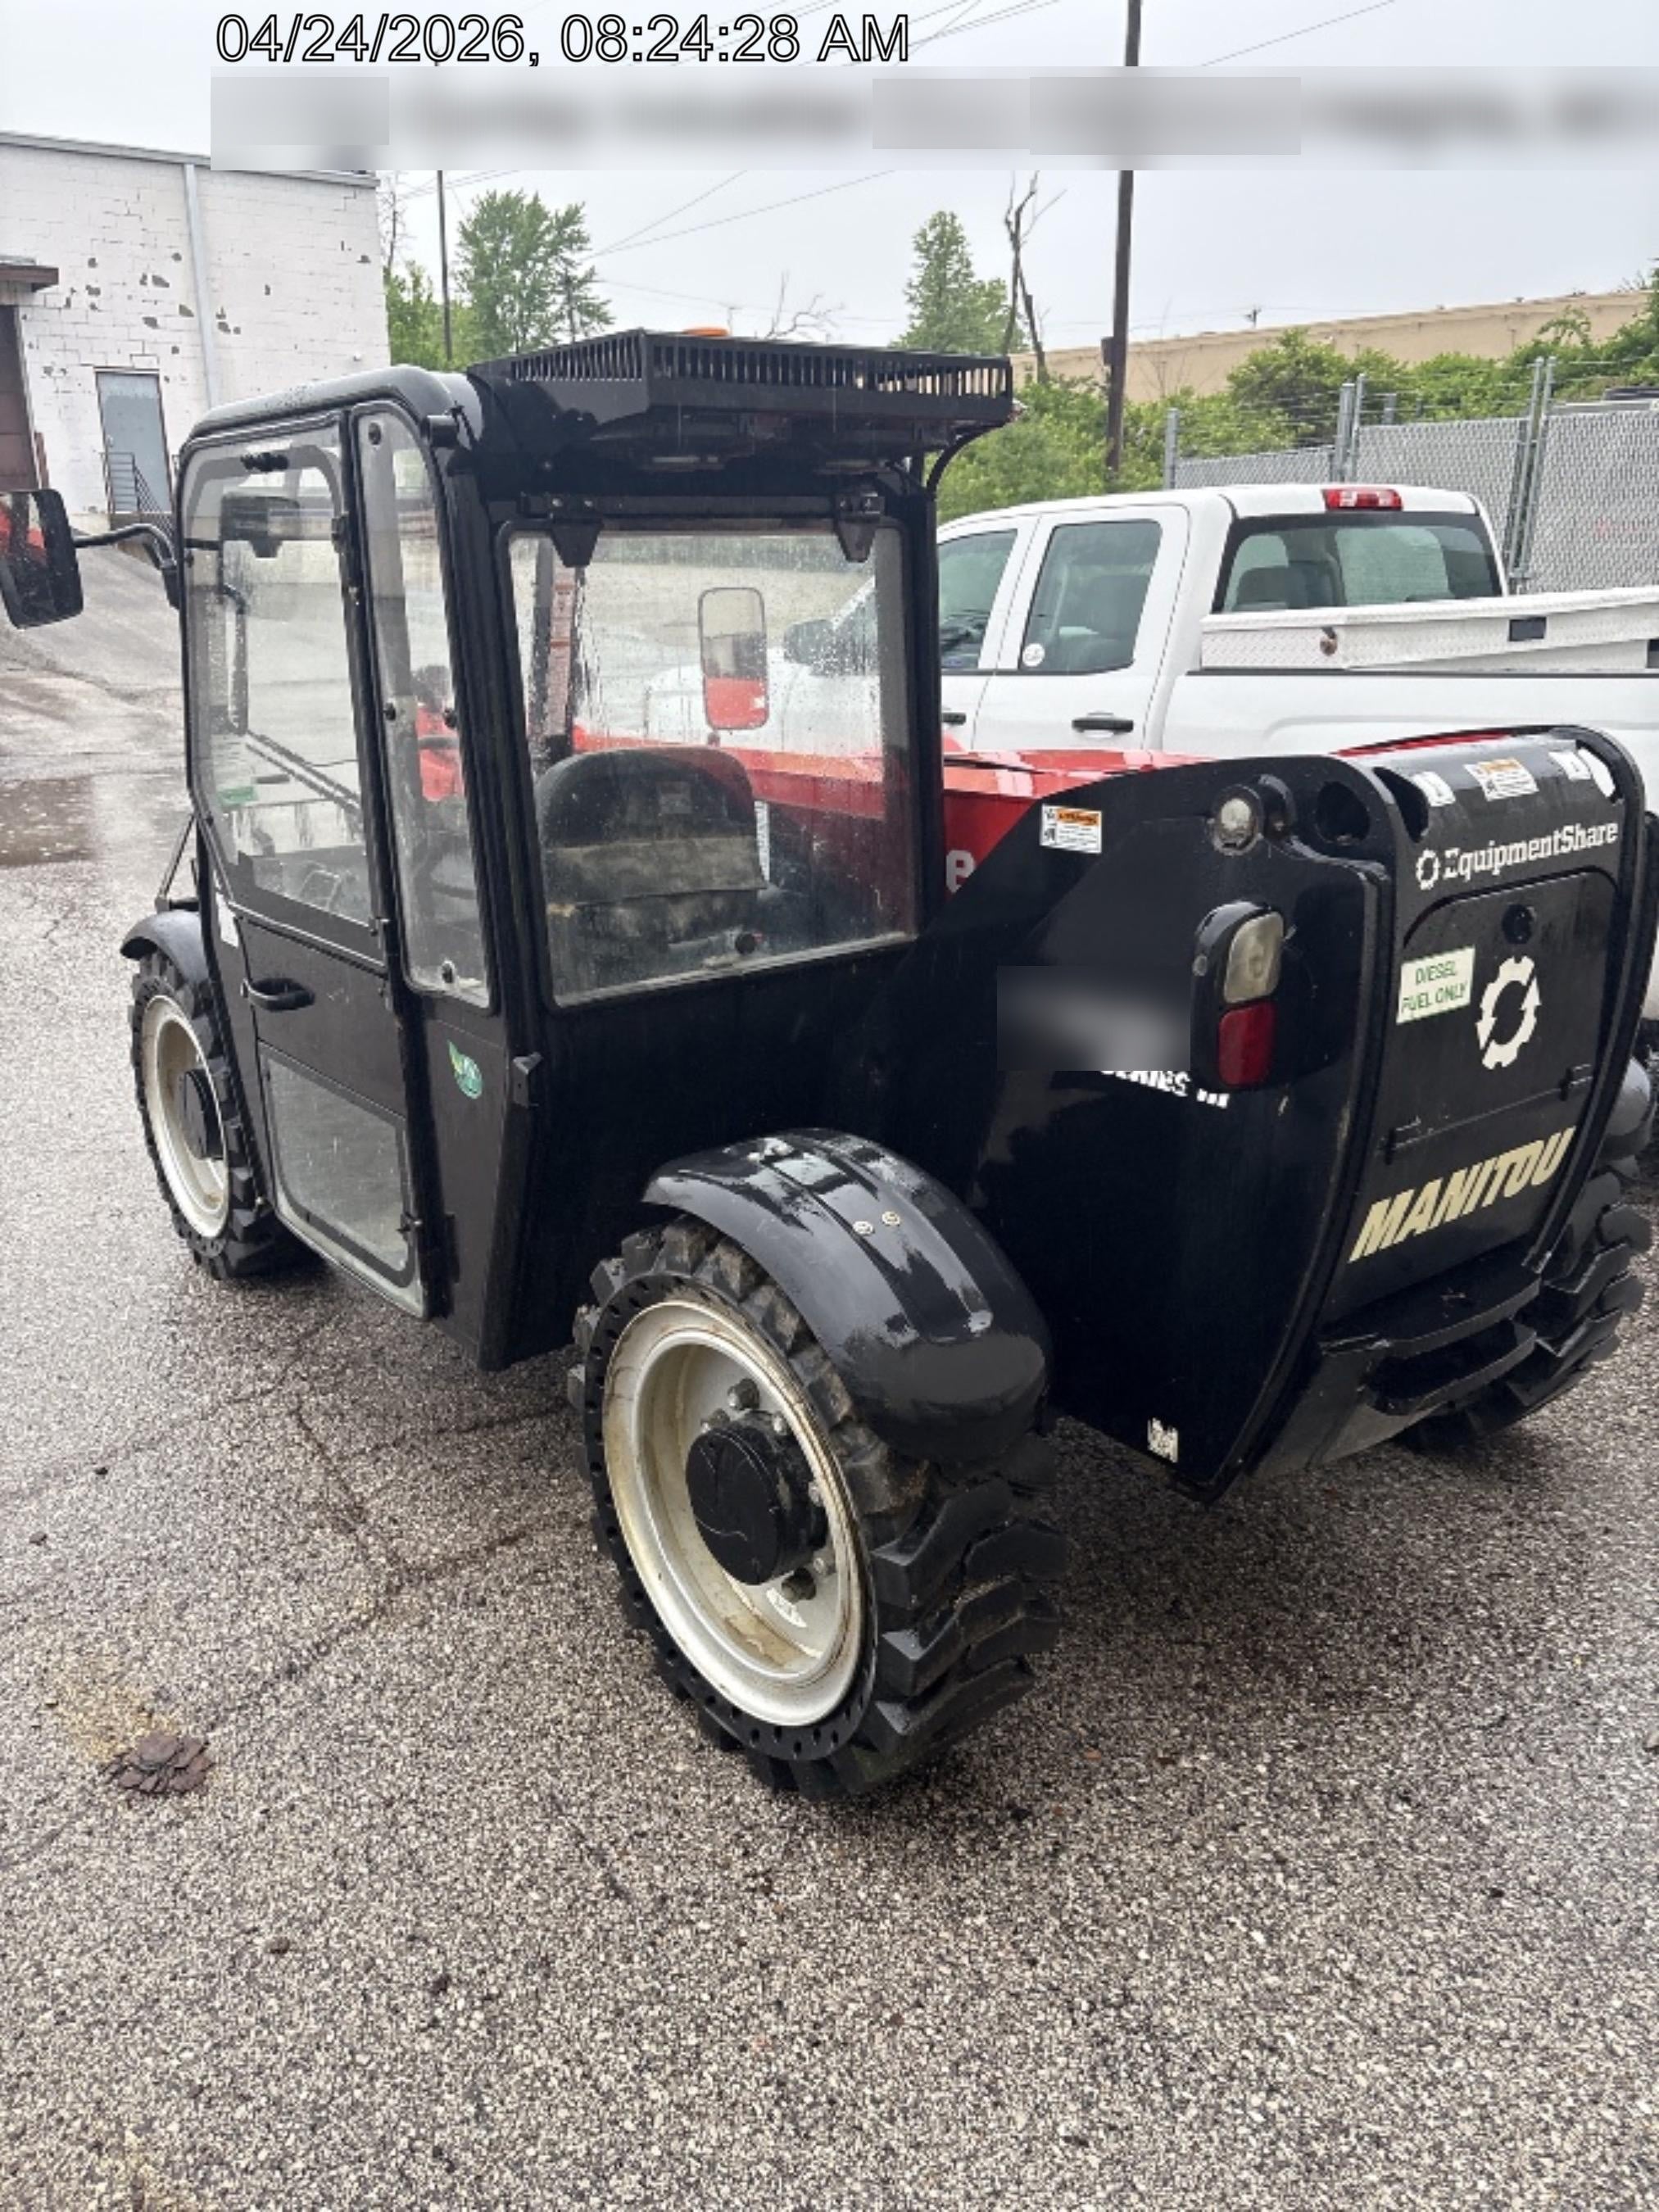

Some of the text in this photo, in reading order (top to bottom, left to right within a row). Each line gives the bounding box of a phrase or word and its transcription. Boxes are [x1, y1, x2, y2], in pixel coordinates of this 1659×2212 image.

[1444, 823, 1619, 882] EquipmentShare
[1415, 960, 1457, 985] DIESEL
[1401, 981, 1467, 1013] FUEL ONLY
[1348, 1126, 1576, 1260] MANITOU
